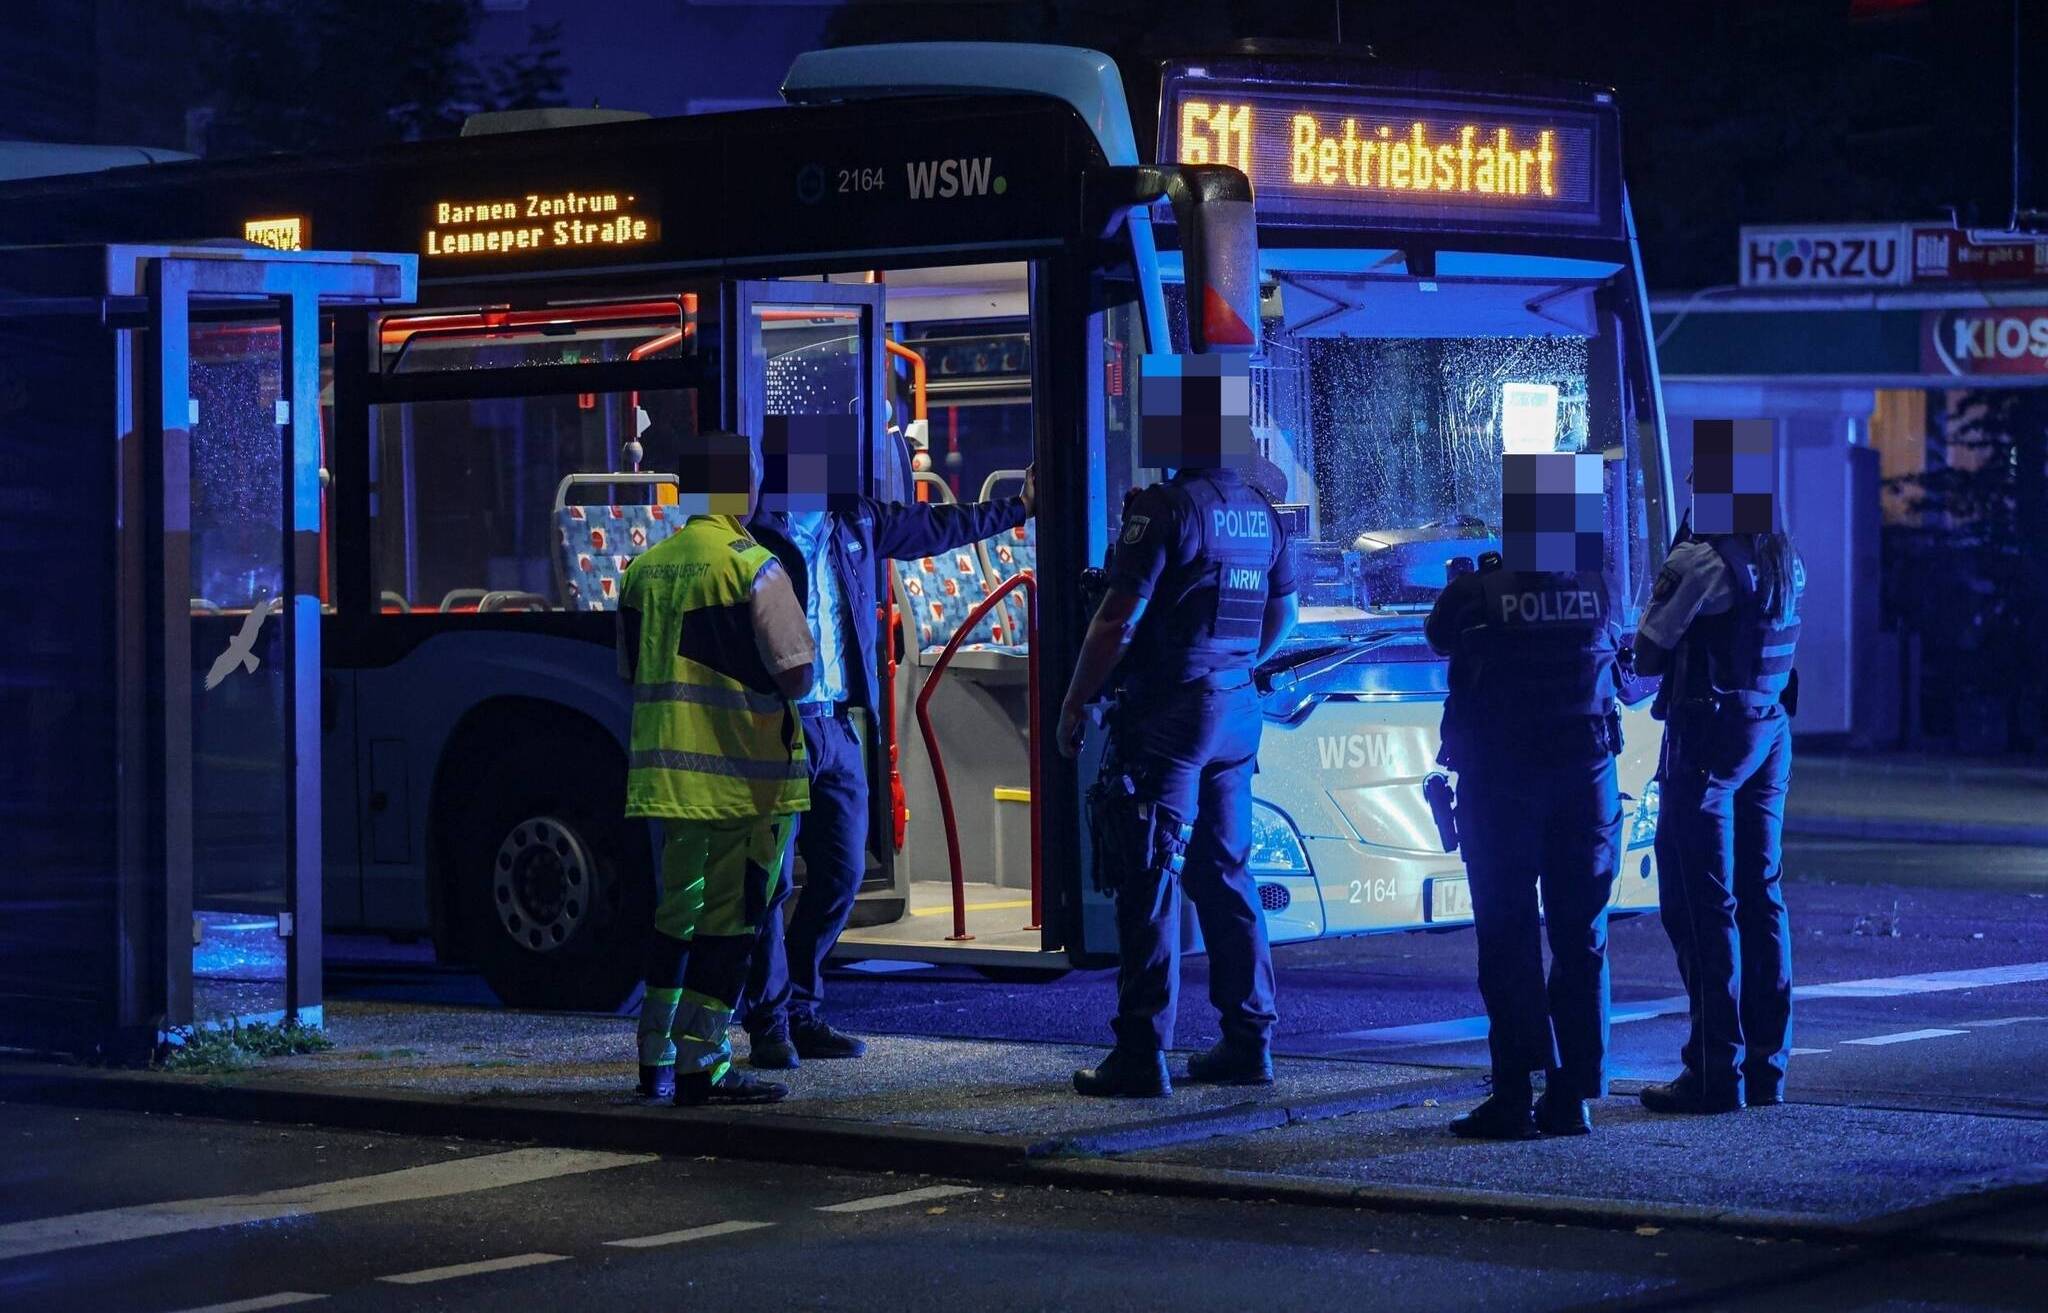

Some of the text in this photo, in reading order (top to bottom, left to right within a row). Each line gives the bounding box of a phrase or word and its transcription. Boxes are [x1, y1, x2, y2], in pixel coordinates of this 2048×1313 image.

[1181, 102, 1555, 196] 611 Betriebsfahrt
[837, 168, 885, 193] 2164
[438, 199, 517, 225] Barmen
[526, 192, 618, 216] Zentrum
[427, 215, 648, 256] Lenneper Straße
[1212, 510, 1270, 538] POLIZEI
[1229, 569, 1262, 590] NRW
[1501, 591, 1601, 622] POLIZEI
[1349, 878, 1398, 904] 2164
